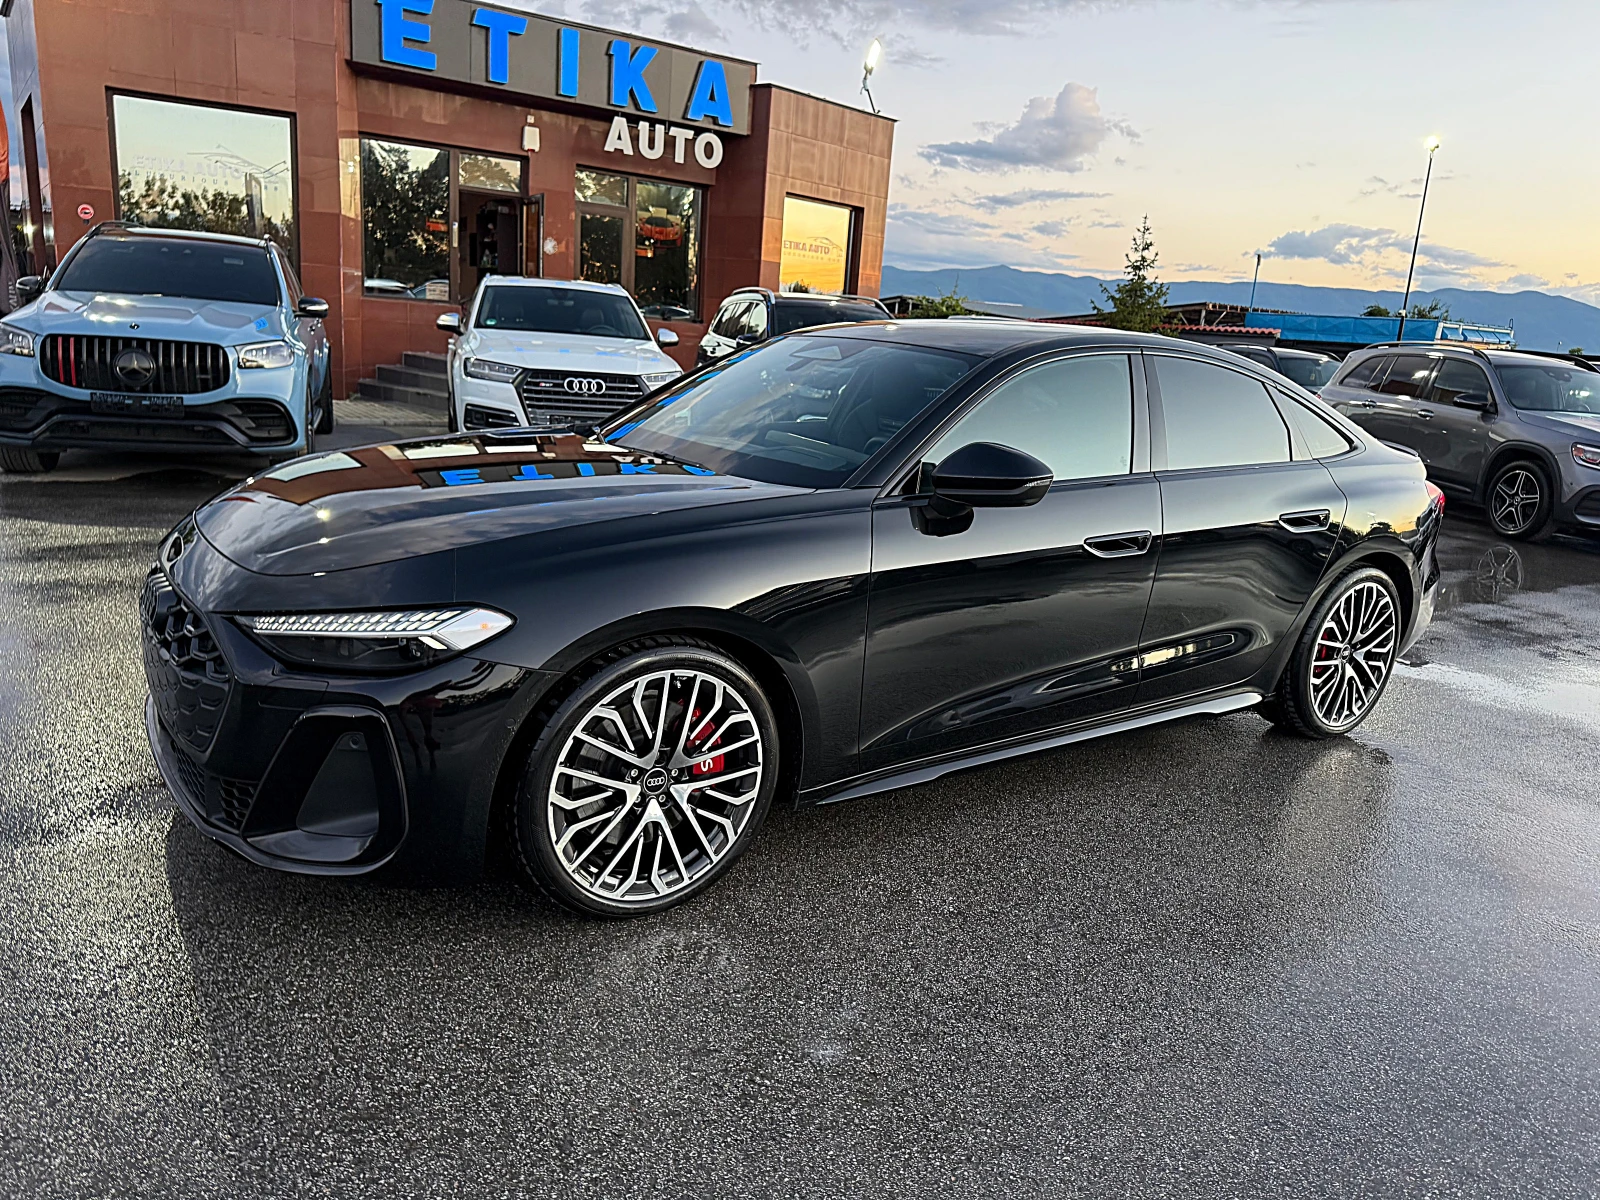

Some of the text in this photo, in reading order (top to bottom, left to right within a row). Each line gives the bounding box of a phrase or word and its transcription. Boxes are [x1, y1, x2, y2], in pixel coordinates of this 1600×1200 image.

[377, 0, 733, 127] ETIKA
[604, 116, 723, 169] AUTO
[195, 161, 243, 180] AUTO
[783, 240, 830, 255] ETIKA AUTO
